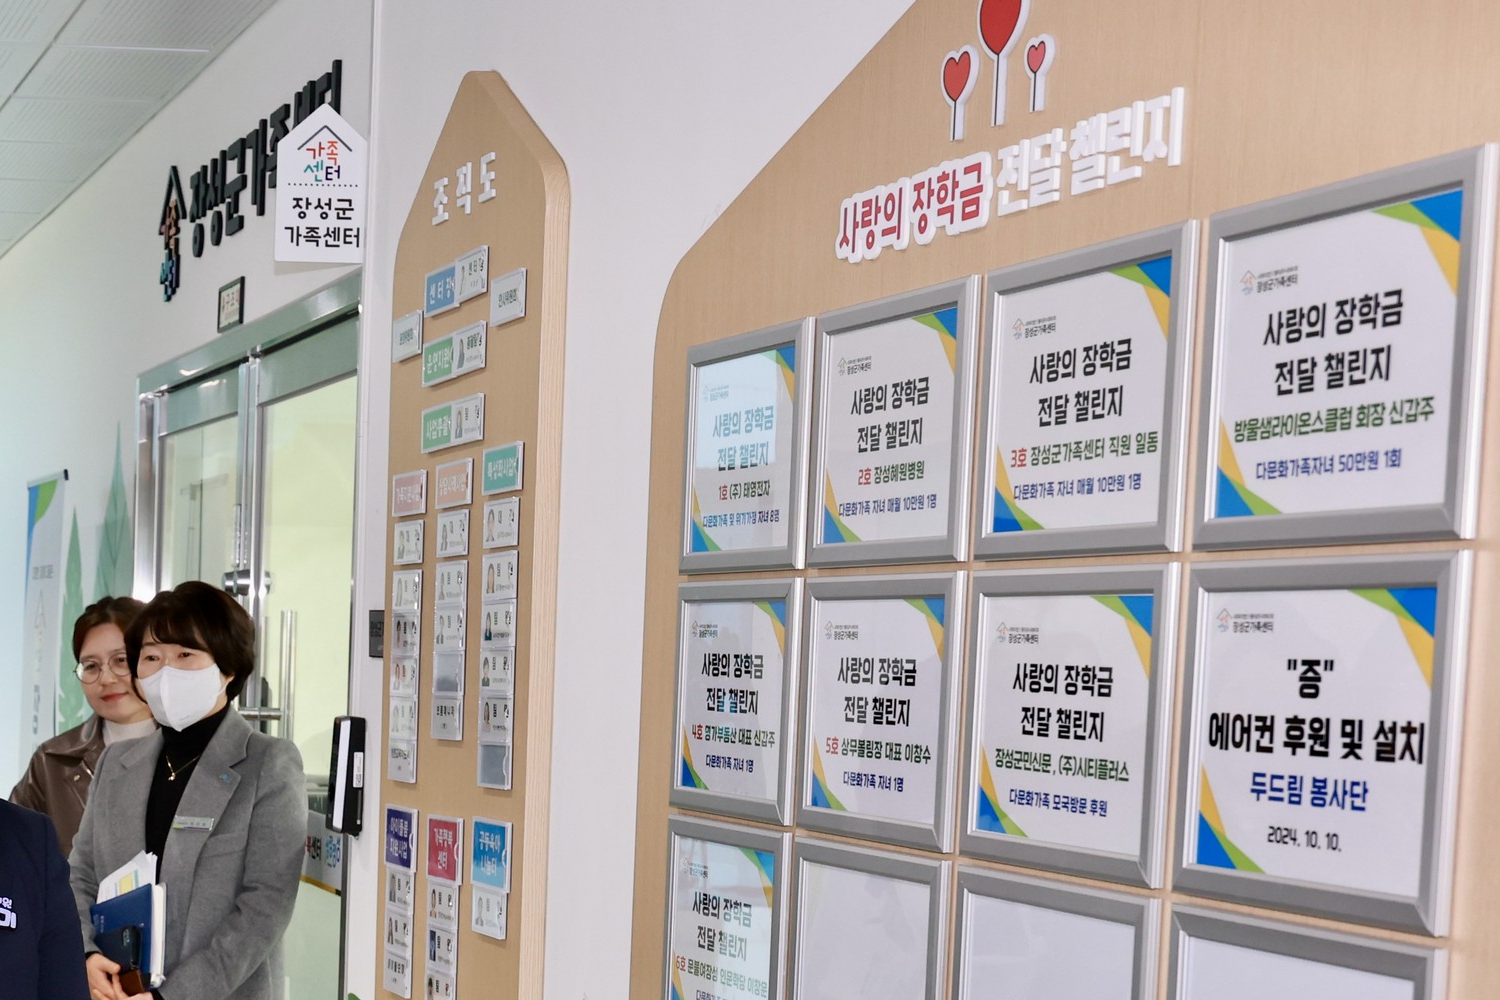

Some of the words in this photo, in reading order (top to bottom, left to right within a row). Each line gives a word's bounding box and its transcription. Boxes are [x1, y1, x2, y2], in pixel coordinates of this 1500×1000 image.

[306, 141, 339, 166] 가족
[303, 164, 342, 183] 센터
[838, 187, 903, 253] 사랑의
[912, 162, 983, 235] 장학금
[997, 128, 1066, 217] 전달
[1070, 87, 1185, 196] 챌린지
[432, 151, 497, 226] 조직도
[291, 196, 355, 221] 장성군
[284, 226, 361, 249] 가족센터
[1263, 302, 1327, 346] 사랑의
[1334, 288, 1404, 335] 장학금
[1030, 348, 1077, 384] 사랑의
[1082, 338, 1132, 377] 장학금
[1274, 356, 1317, 397] 전달
[1324, 345, 1392, 390] 챌린지
[851, 384, 887, 415] 사랑의
[891, 376, 930, 408] 장학금
[1038, 395, 1069, 428] 전달
[1074, 385, 1124, 424] 챌린지
[713, 411, 741, 438] 사랑의
[745, 405, 773, 433] 장학금
[857, 423, 882, 453] 전달
[885, 417, 923, 450] 챌린지
[1234, 408, 1353, 444] 방울샘라이온스클럽
[1355, 402, 1386, 429] 회장
[1389, 396, 1435, 425] 신갑주
[718, 446, 737, 471] 전달
[740, 441, 768, 469] 챌린지
[1010, 447, 1028, 468] 3호
[1030, 437, 1105, 467] 장성군가족센터
[1108, 434, 1132, 457] 직원
[1135, 431, 1159, 454] 일동
[1255, 452, 1335, 481] 다문화가족자녀
[1338, 450, 1380, 474] 50만원
[1383, 447, 1403, 470] 1회
[858, 468, 872, 486] 2호
[874, 460, 925, 484] 장성혜원병원
[1013, 479, 1055, 501] 다문화가족
[1056, 478, 1075, 497] 자녀
[1076, 476, 1095, 496] 매월
[1097, 473, 1125, 493] 10만원
[1127, 472, 1142, 491] 1명
[718, 484, 728, 501] 1호
[729, 482, 741, 500] (주)
[838, 500, 871, 517] 다문화가족
[872, 499, 886, 514] 자녀
[887, 497, 900, 513] 매월
[903, 495, 925, 511] 10만원
[926, 494, 937, 509] 1명
[702, 513, 728, 528] 다문화가족
[757, 509, 769, 523] 자녀
[702, 652, 731, 679] 사랑의
[733, 653, 764, 680] 장학금
[837, 657, 874, 685] 사랑의
[878, 657, 917, 686] 장학금
[1013, 663, 1059, 695] 사랑의
[1064, 665, 1113, 698] 장학금
[706, 688, 726, 713] 전달
[728, 688, 759, 716] 챌린지
[844, 696, 869, 724] 전달
[871, 696, 910, 727] 챌린지
[692, 724, 703, 740] 4호
[738, 728, 752, 745] 대표
[754, 729, 775, 748] 신갑주
[1020, 706, 1052, 738] 전달
[1056, 707, 1105, 742] 챌린지
[1208, 712, 1275, 753] 에어컨
[1283, 714, 1331, 758] 후원
[1340, 719, 1364, 761] 및
[1374, 720, 1425, 764] 설치
[705, 754, 732, 770] 다문화가족
[732, 758, 744, 772] 자녀
[745, 759, 754, 773] 1명
[826, 736, 839, 755] 5호
[841, 737, 883, 760] 상무볼링장
[885, 742, 902, 762] 대표
[904, 742, 932, 765] 이창수
[843, 771, 877, 790] 다문화가족
[877, 775, 892, 791] 자녀
[893, 776, 904, 793] 1명
[1058, 753, 1130, 782] (주)시티플러스
[1009, 788, 1050, 810] 다문화가족
[1052, 792, 1088, 815] 모국방문
[1089, 798, 1108, 818] 후원
[1250, 772, 1304, 806] 두드림
[1310, 777, 1369, 812] 봉사단
[1267, 826, 1301, 847] 2024.
[1305, 830, 1321, 850] 10.
[1325, 832, 1342, 852] 10.
[692, 891, 720, 919] 사랑의
[723, 898, 752, 928] 장학금
[697, 925, 716, 952] 전달
[718, 930, 747, 961] 챌린지
